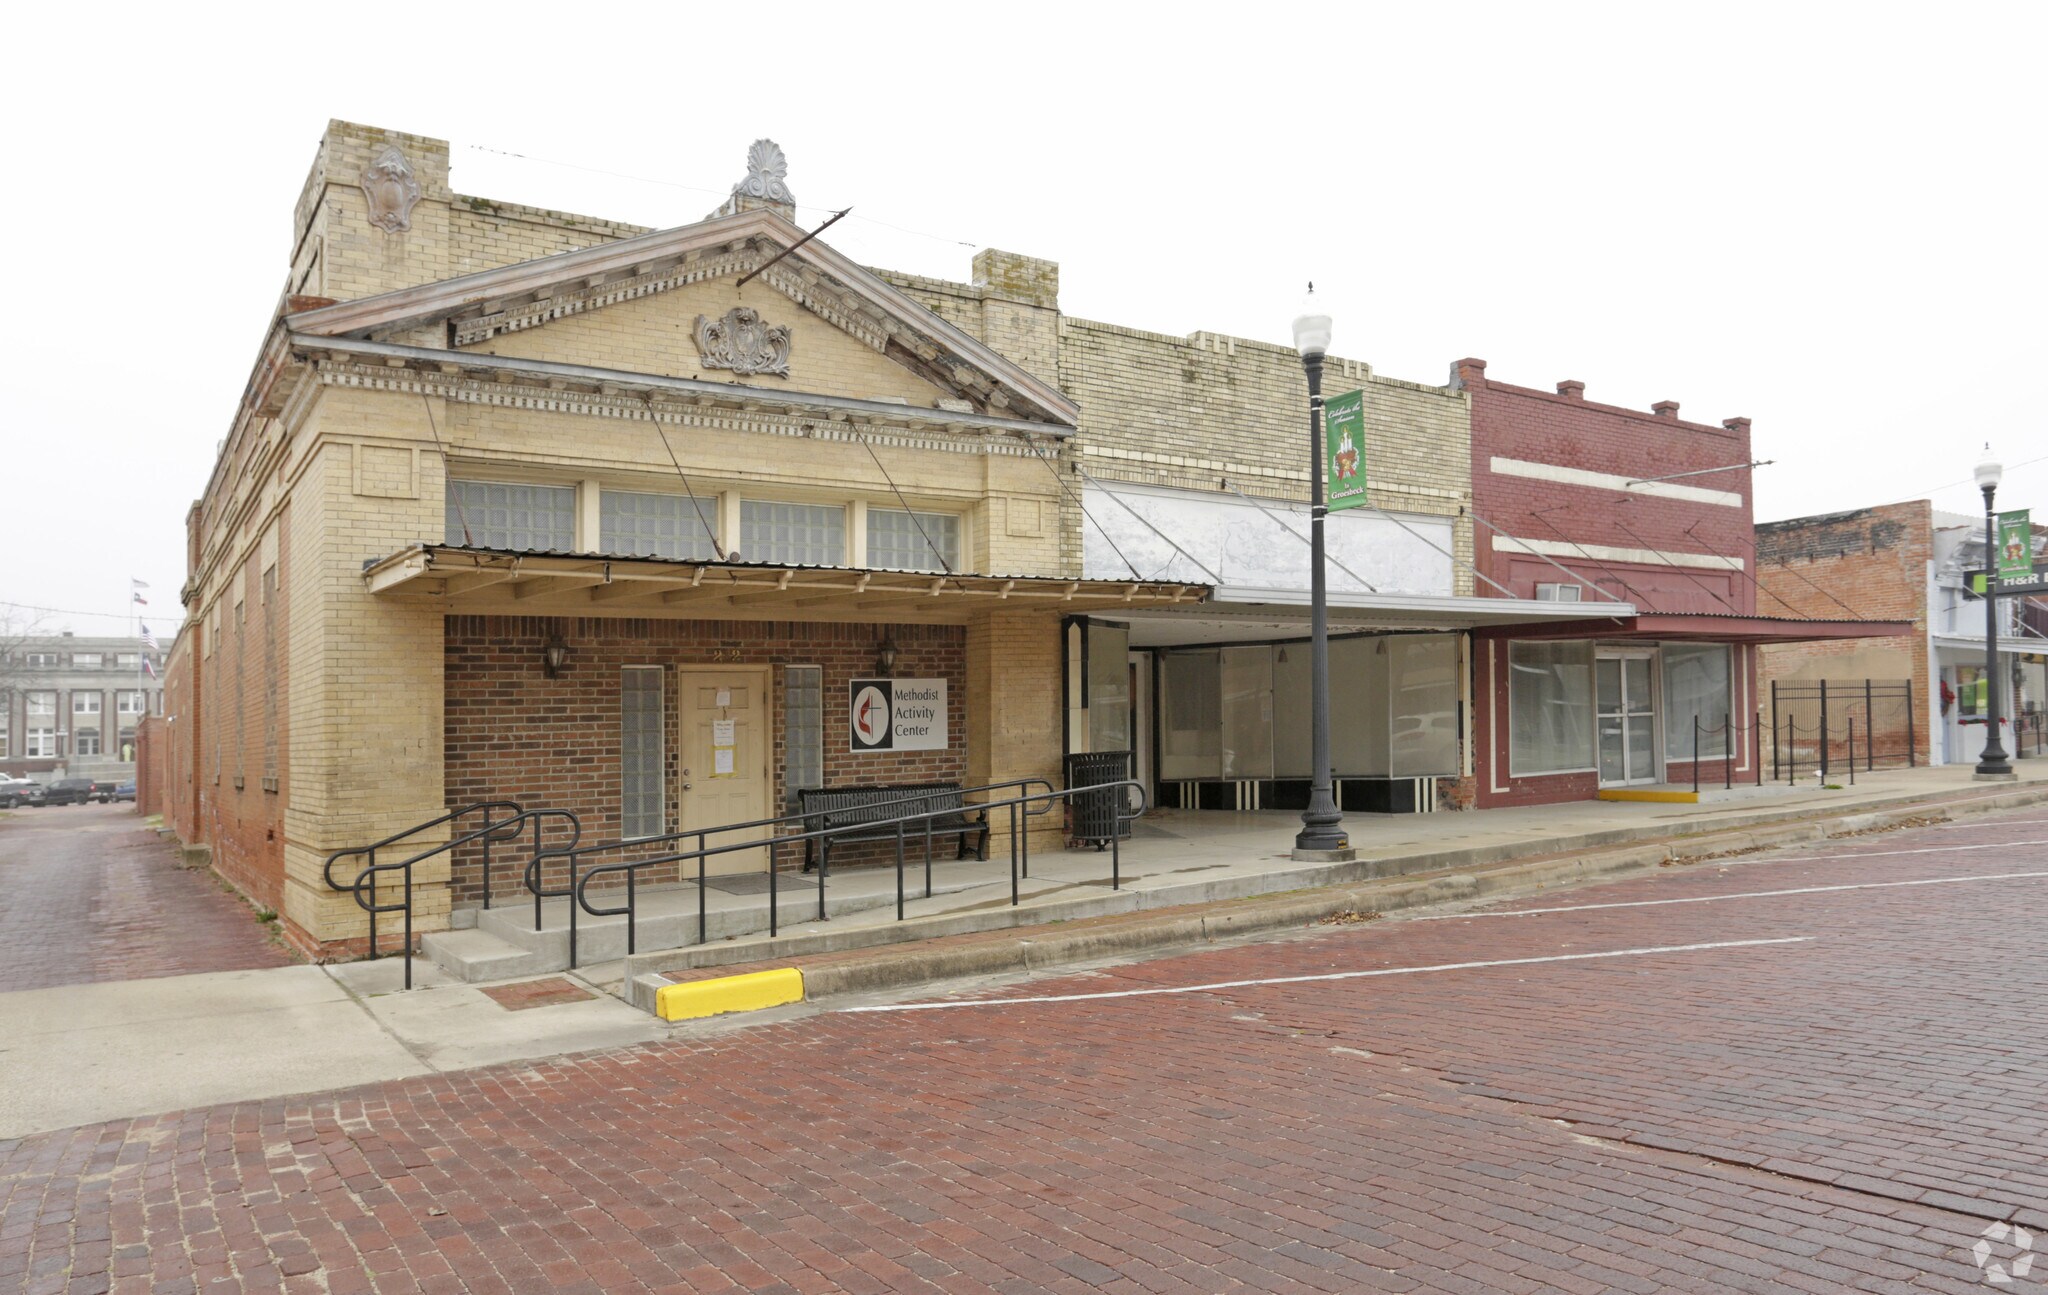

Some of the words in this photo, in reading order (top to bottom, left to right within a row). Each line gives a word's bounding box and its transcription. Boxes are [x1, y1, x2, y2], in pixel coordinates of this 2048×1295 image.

[1331, 486, 1364, 499] Groesbeck
[2003, 573, 2039, 586] H&R
[894, 688, 939, 701] Methodist
[895, 706, 935, 722] Activity
[895, 724, 929, 736] Center
